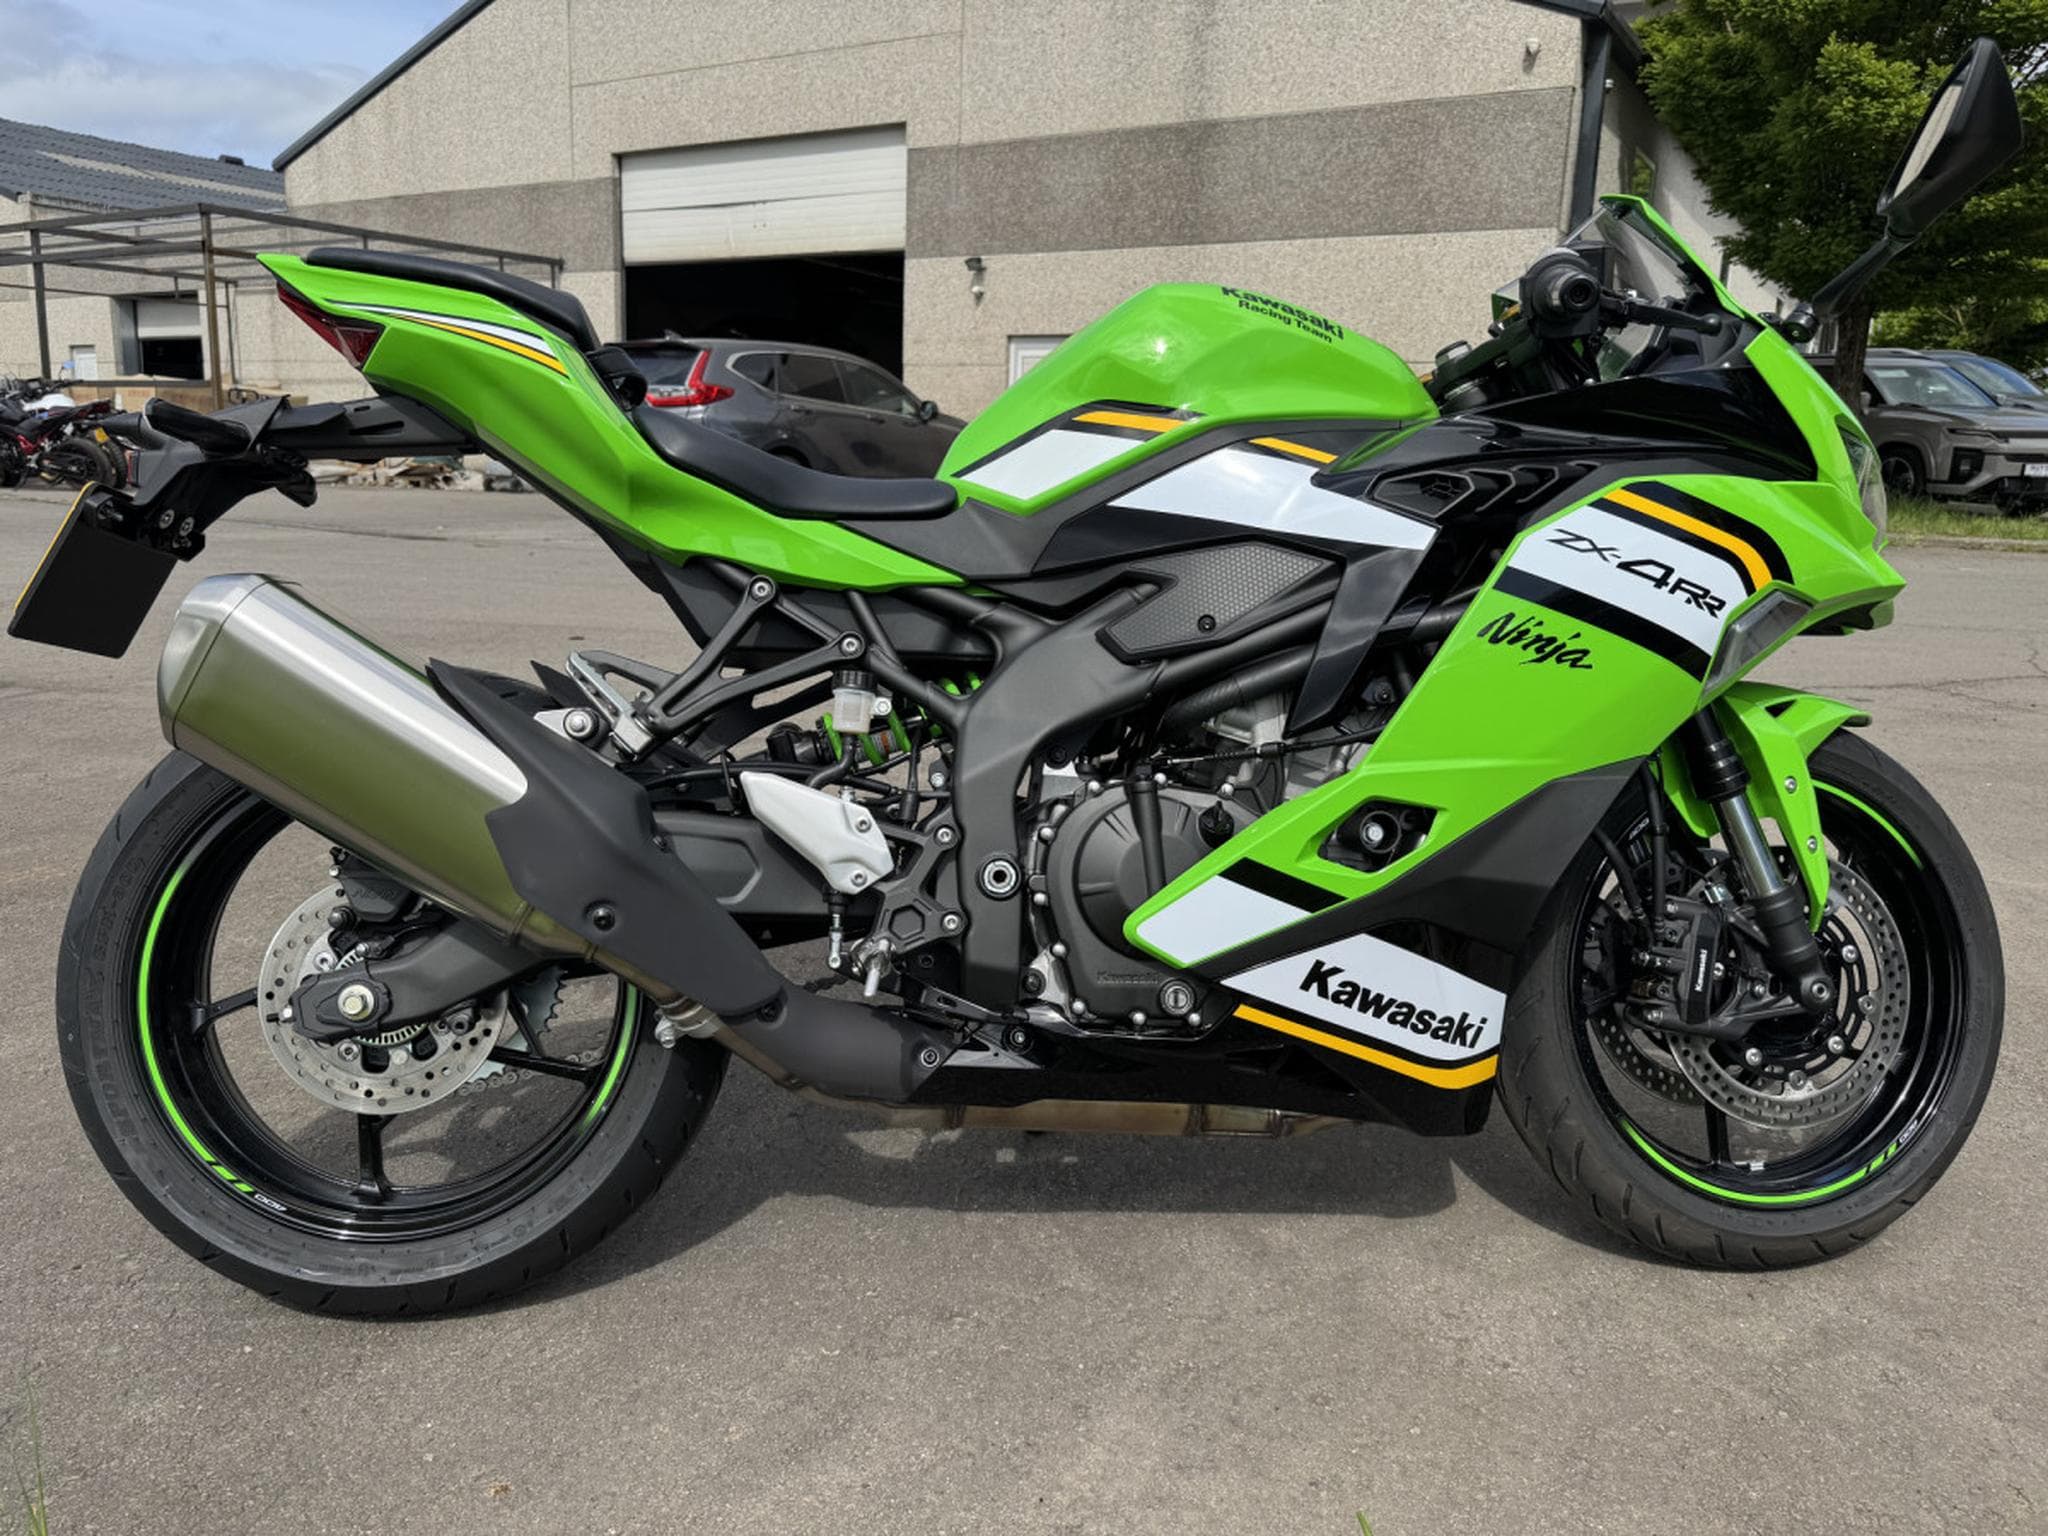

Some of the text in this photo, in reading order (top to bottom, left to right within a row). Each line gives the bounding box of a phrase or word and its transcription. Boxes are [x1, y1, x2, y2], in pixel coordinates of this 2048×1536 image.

[1220, 286, 1344, 340] Kawasaki
[1238, 299, 1333, 343] Racing Team
[1477, 612, 1593, 670] Ninja
[1300, 959, 1488, 1049] Kawasaki
